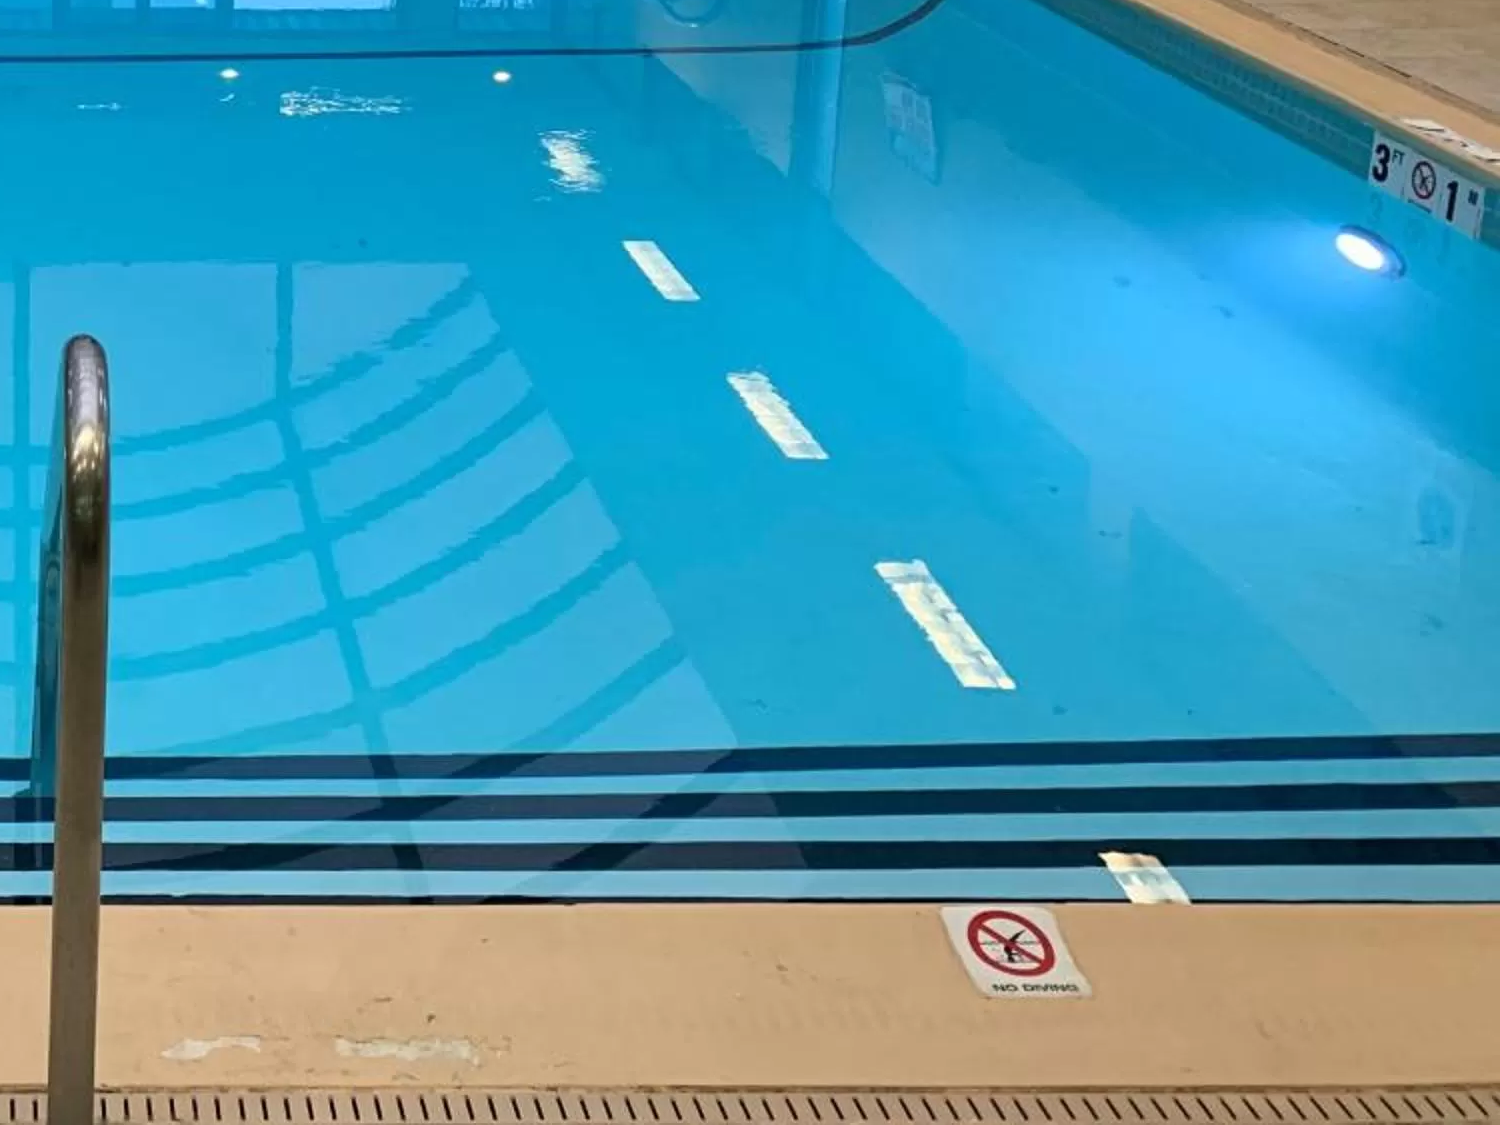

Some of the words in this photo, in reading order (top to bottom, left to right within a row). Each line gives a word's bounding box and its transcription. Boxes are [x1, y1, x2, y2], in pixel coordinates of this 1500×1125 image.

[1372, 143, 1390, 182] 3
[1446, 180, 1459, 221] 1
[992, 983, 1019, 992] NO
[1022, 983, 1079, 992] DIVING
